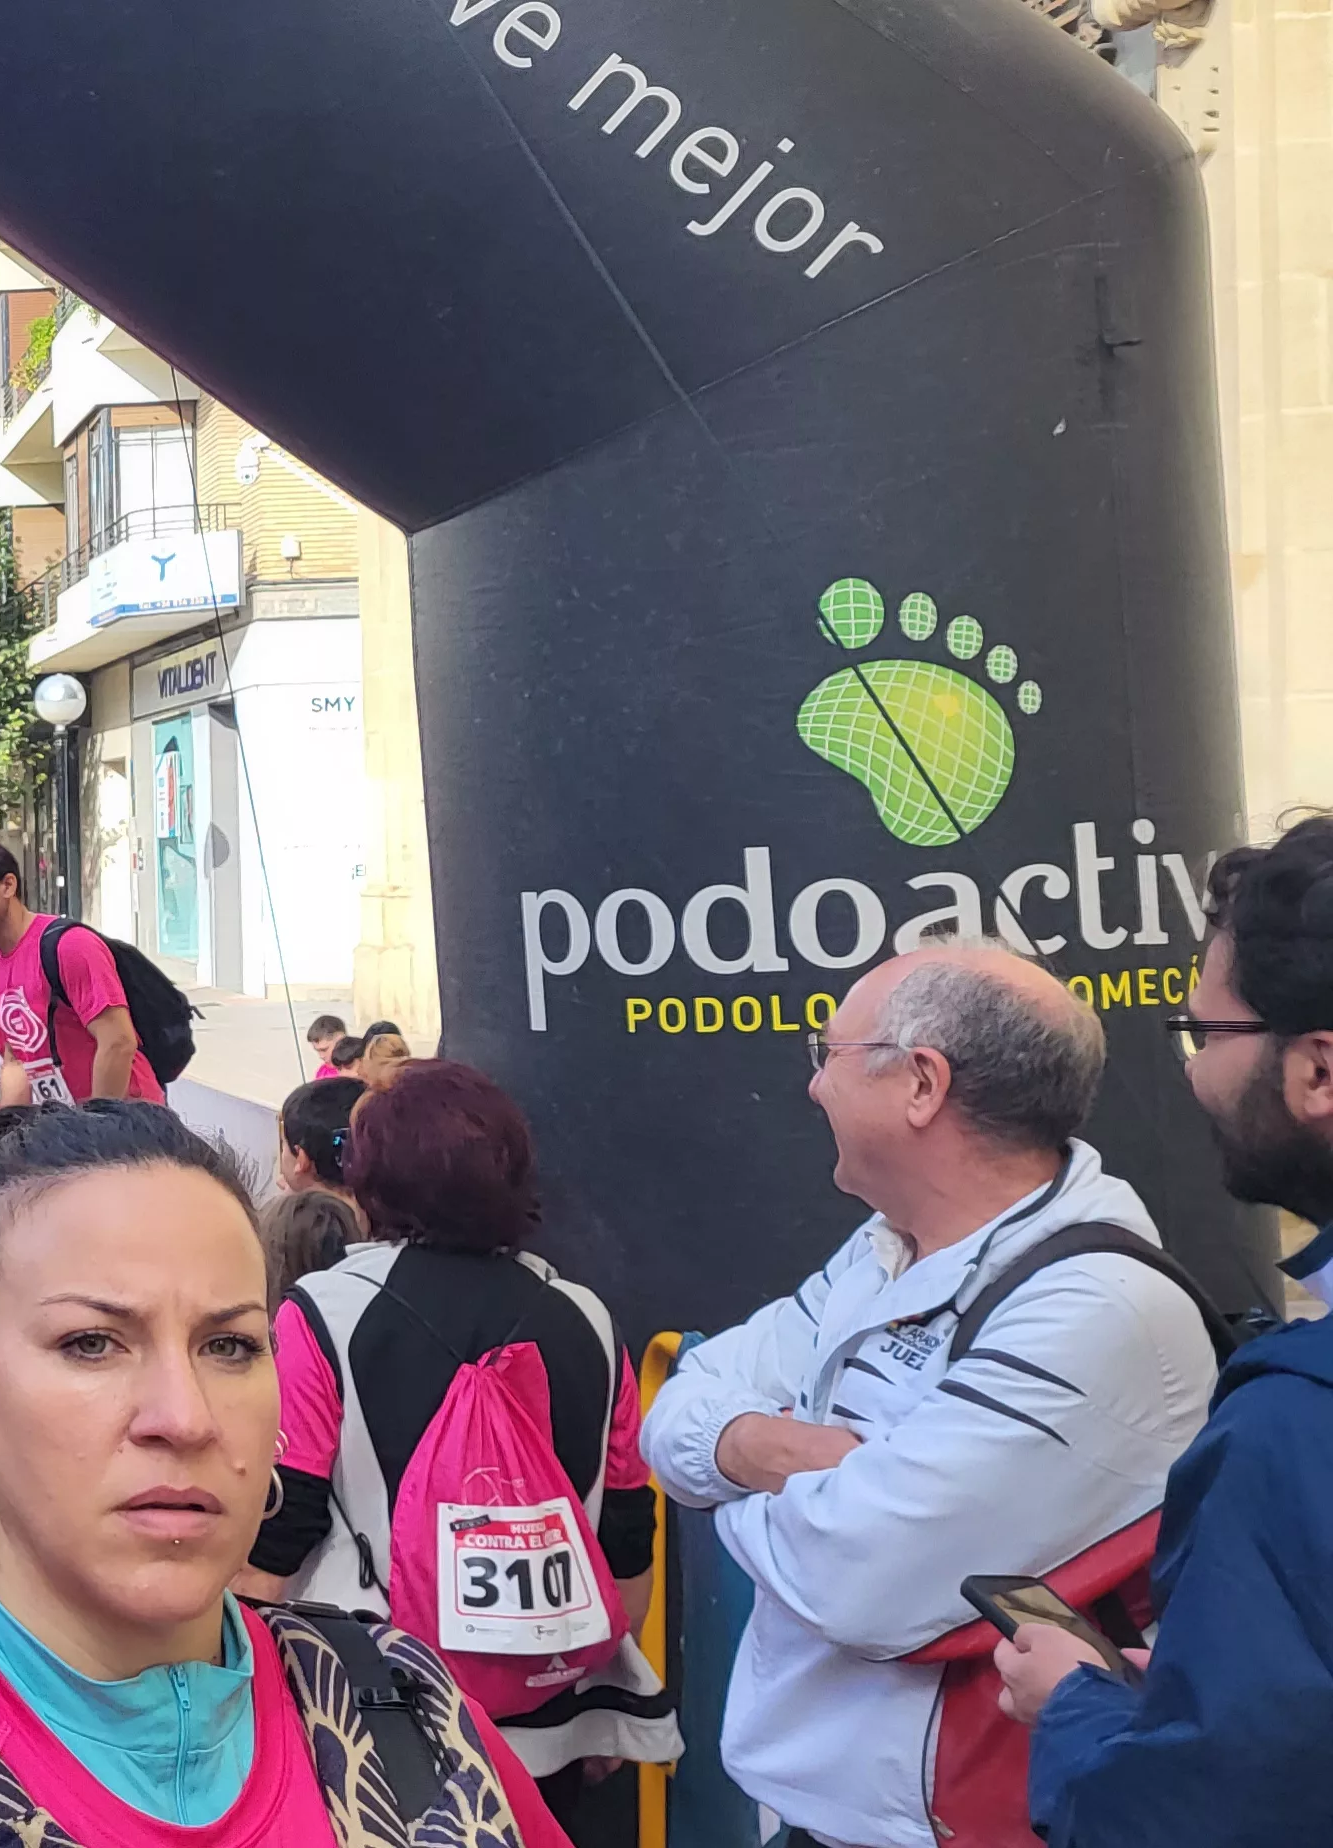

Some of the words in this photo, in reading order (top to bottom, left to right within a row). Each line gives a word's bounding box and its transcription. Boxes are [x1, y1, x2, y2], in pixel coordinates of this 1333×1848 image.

[566, 52, 885, 280] mejor
[311, 696, 356, 713] SMY
[463, 1533, 527, 1548] CONTRA
[462, 1550, 573, 1610] 3107
